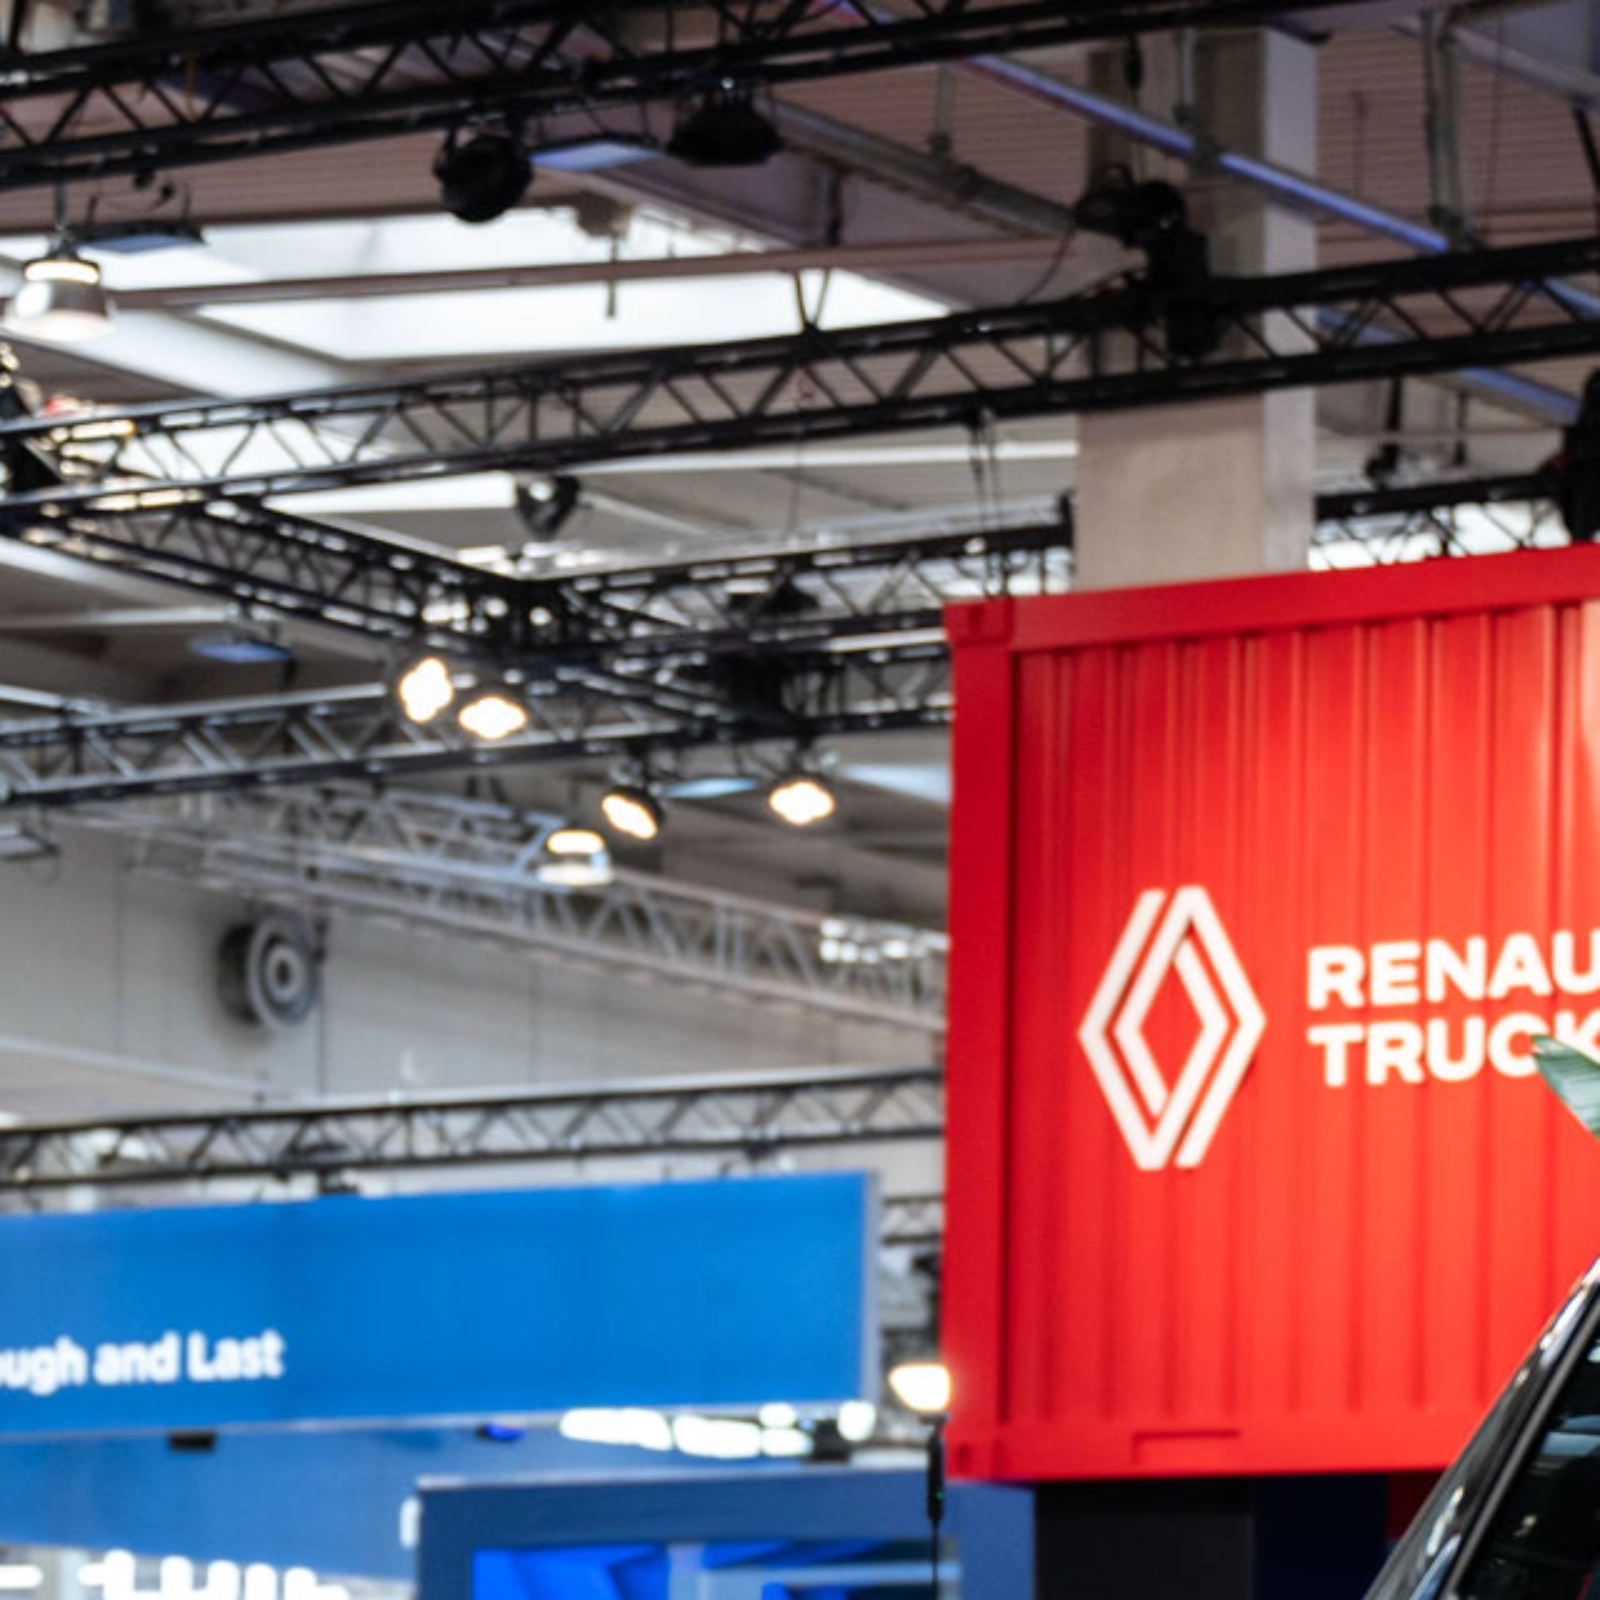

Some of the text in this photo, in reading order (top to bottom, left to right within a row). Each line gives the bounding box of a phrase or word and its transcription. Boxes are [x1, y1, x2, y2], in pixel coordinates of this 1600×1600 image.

[1307, 929, 1600, 1010] RENAU
[93, 1331, 181, 1384] and
[187, 1329, 285, 1381] Last
